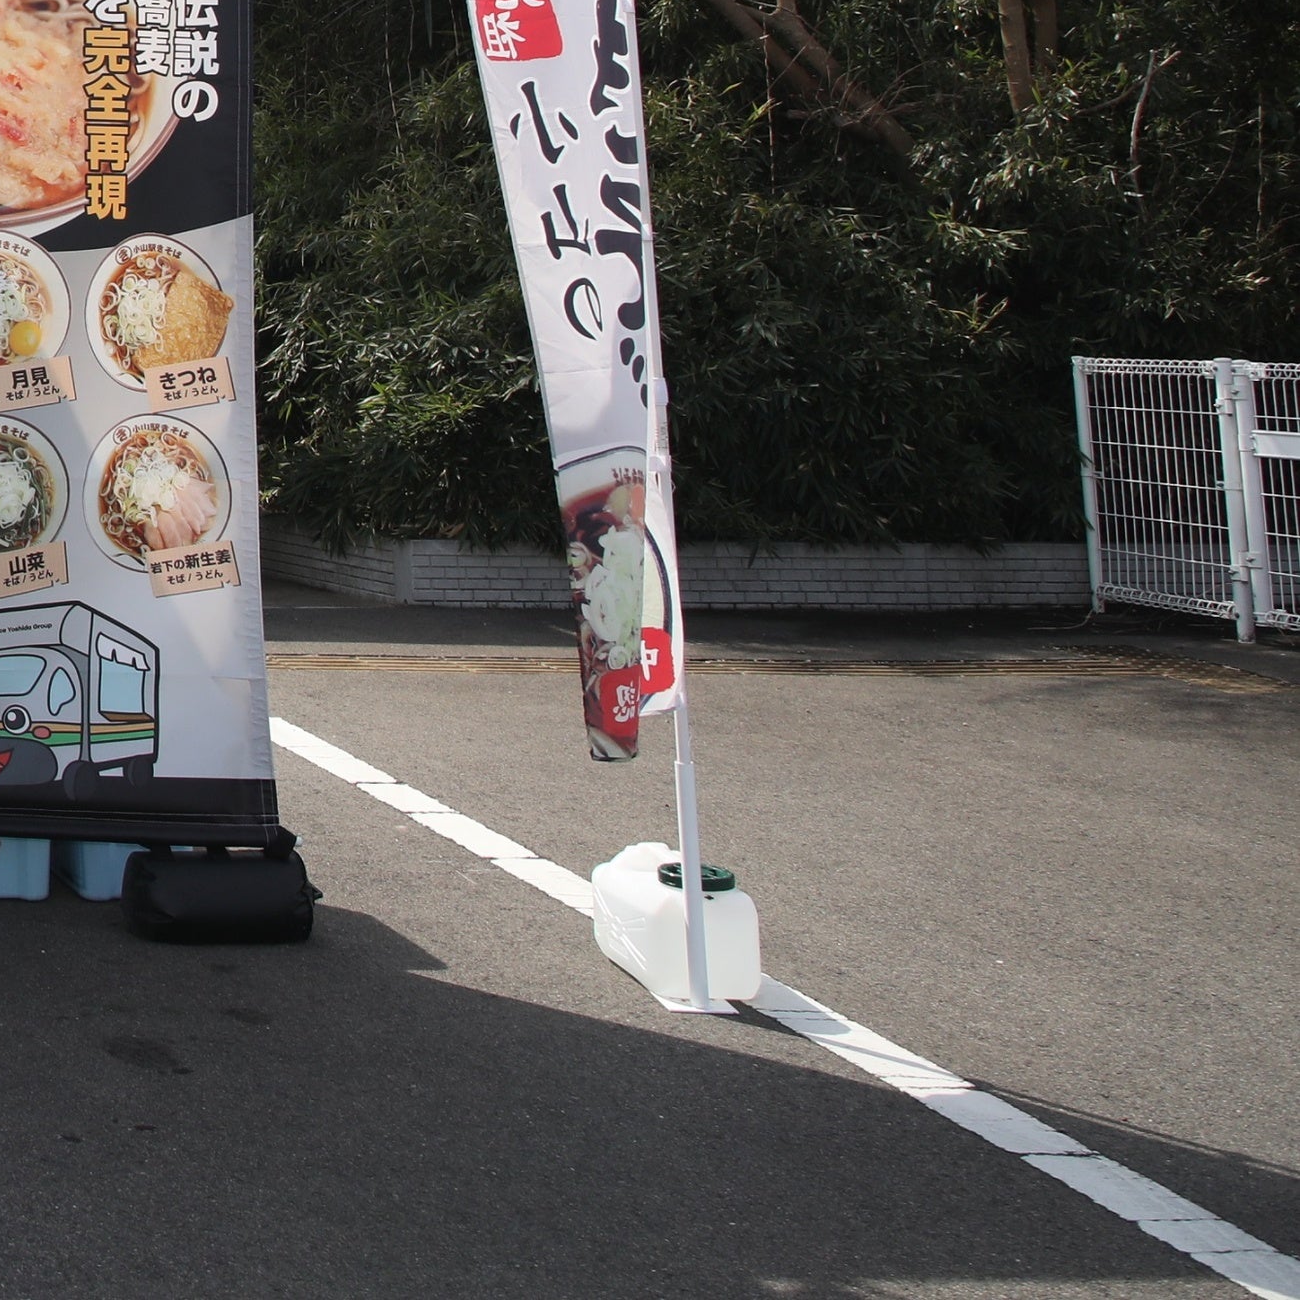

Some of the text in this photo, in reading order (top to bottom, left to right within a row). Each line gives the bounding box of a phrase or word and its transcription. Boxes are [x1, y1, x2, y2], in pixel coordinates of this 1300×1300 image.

[132, 243, 183, 260] 小山駅きそば
[12, 366, 51, 390] 月見
[159, 366, 218, 390] きつね
[132, 423, 190, 440] 小山駅きそば
[9, 551, 46, 575] 山菜
[150, 549, 232, 575] 岩下の新生姜
[8, 623, 33, 633] Yoshida
[33, 621, 54, 631] Group
